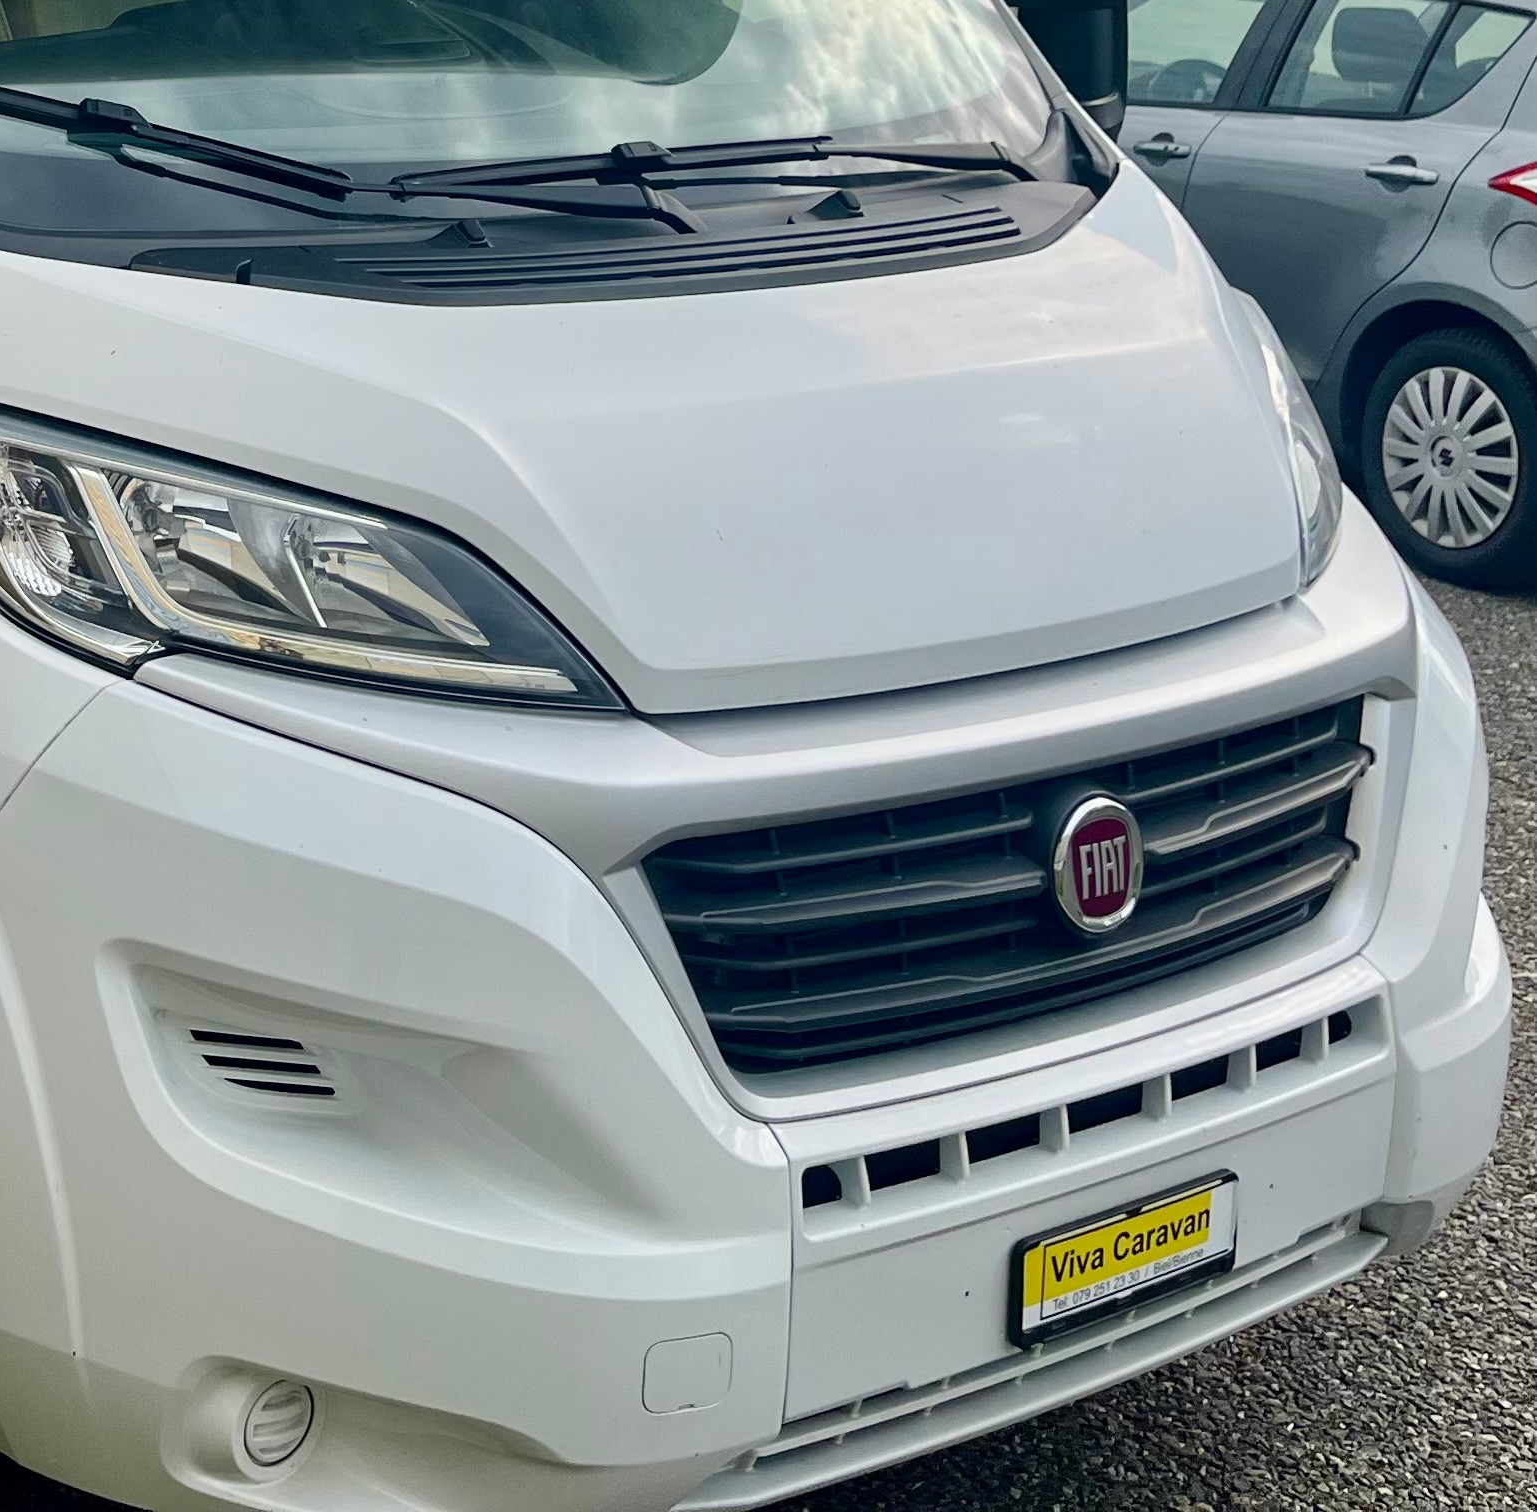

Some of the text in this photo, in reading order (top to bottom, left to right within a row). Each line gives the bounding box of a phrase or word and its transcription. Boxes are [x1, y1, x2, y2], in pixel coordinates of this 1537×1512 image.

[1078, 834, 1127, 901] FIAT
[1051, 1207, 1211, 1283] Viva Caravan
[1072, 1287, 1091, 1305] 079
[1113, 1275, 1126, 1290] 23
[1127, 1269, 1140, 1284] 30
